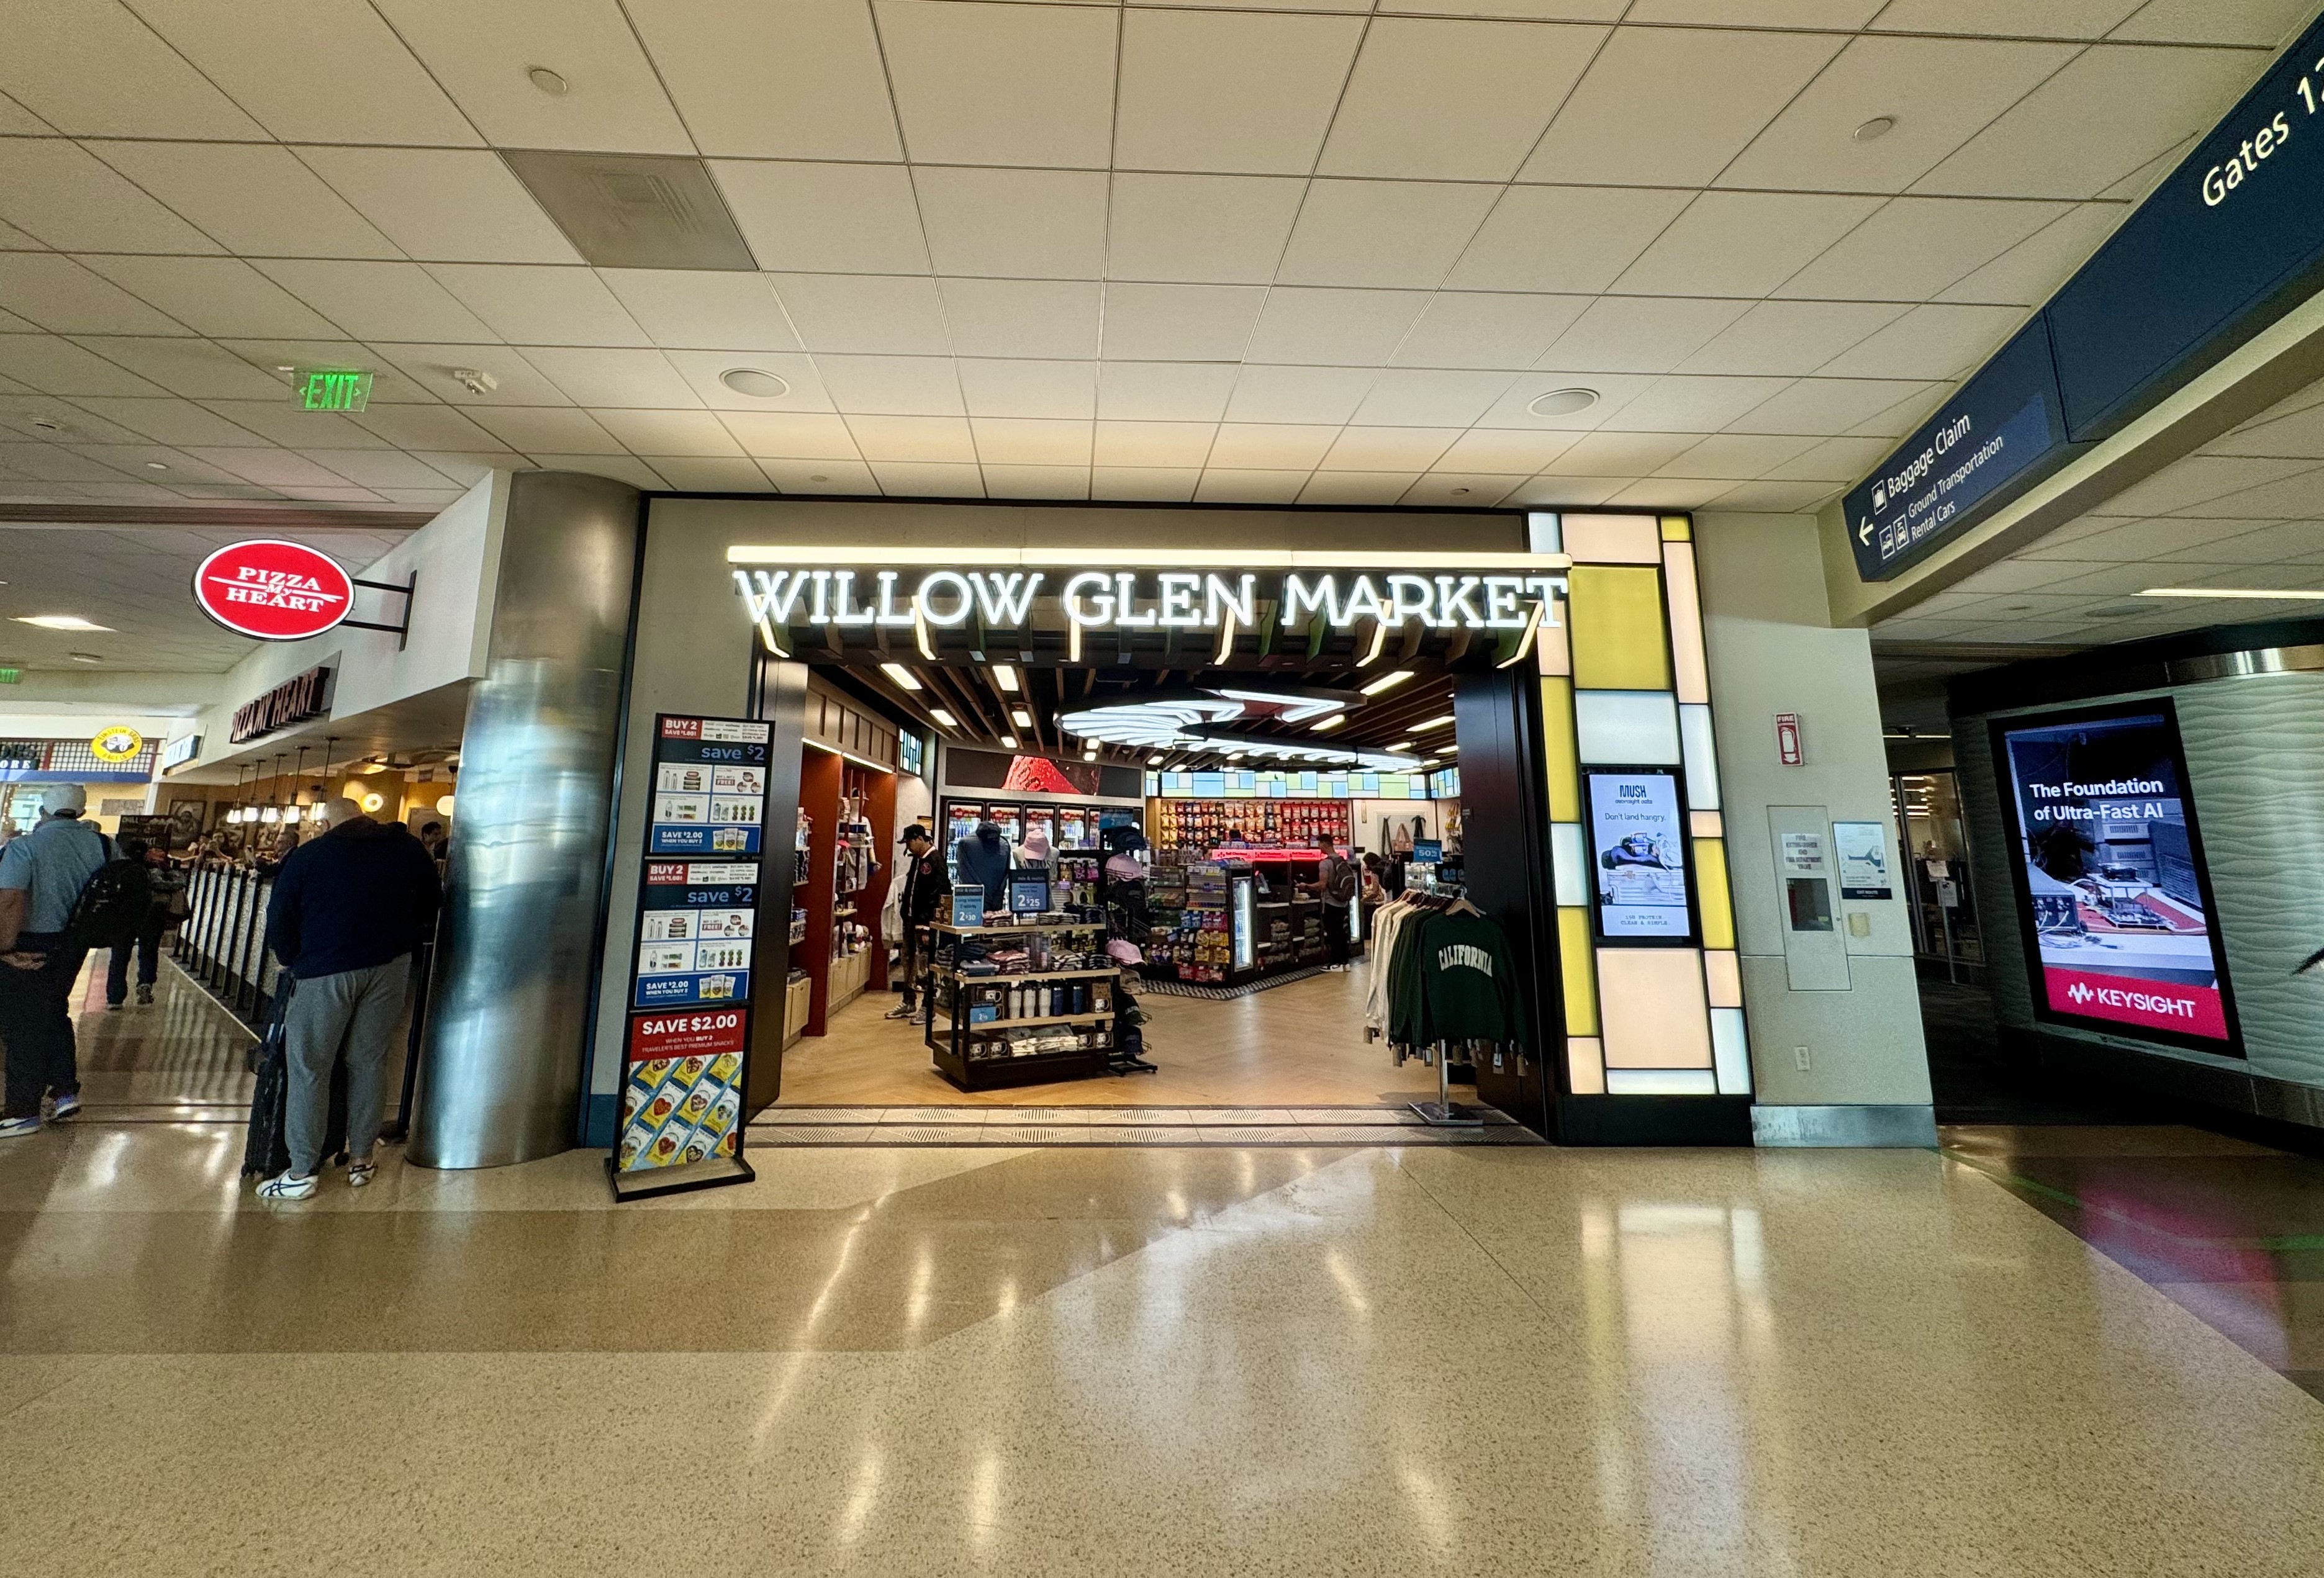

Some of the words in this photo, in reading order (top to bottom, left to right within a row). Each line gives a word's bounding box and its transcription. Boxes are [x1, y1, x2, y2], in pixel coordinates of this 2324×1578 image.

[2203, 112, 2290, 206] Gates
[305, 374, 359, 409] EXIT
[1888, 448, 1934, 498] Baggage
[1936, 415, 1971, 455] Claim
[1909, 484, 1937, 518] Ground
[1938, 436, 2004, 495] Transportation
[1911, 512, 1936, 541] Rental
[1937, 501, 1956, 521] Cars
[237, 566, 322, 591] PIZZA
[225, 587, 324, 613] HEART
[265, 584, 292, 597] My
[732, 570, 1044, 626] WILLOW
[1063, 572, 1257, 626] GLEN
[1281, 574, 1569, 628] MARKET
[271, 667, 319, 727] HEART
[666, 719, 687, 730] BUY
[690, 721, 698, 730] 2
[701, 747, 742, 760] save
[747, 744, 765, 761] $2
[0, 759, 31, 769] ORE
[1619, 785, 1647, 798] MUSH
[2029, 783, 2061, 798] The
[2063, 777, 2164, 798] Foundation
[1640, 813, 1666, 823] hangry.
[2033, 806, 2051, 821] of
[2053, 803, 2140, 821] Ultra-Fast
[2143, 802, 2164, 819] AI
[650, 865, 675, 875] BUY
[676, 865, 684, 874] 2
[687, 891, 730, 903] save
[735, 886, 753, 902] $2
[1018, 895, 1026, 907] 2
[1026, 898, 1040, 907] $25
[959, 911, 965, 921] 2
[1438, 944, 1493, 978] CALIFORNIA
[646, 982, 667, 990] SAVE
[668, 981, 689, 989] $2.00
[2097, 988, 2195, 1019] KEYSIGHT
[642, 1019, 688, 1035] SAVE
[691, 1014, 738, 1032] $2.00
